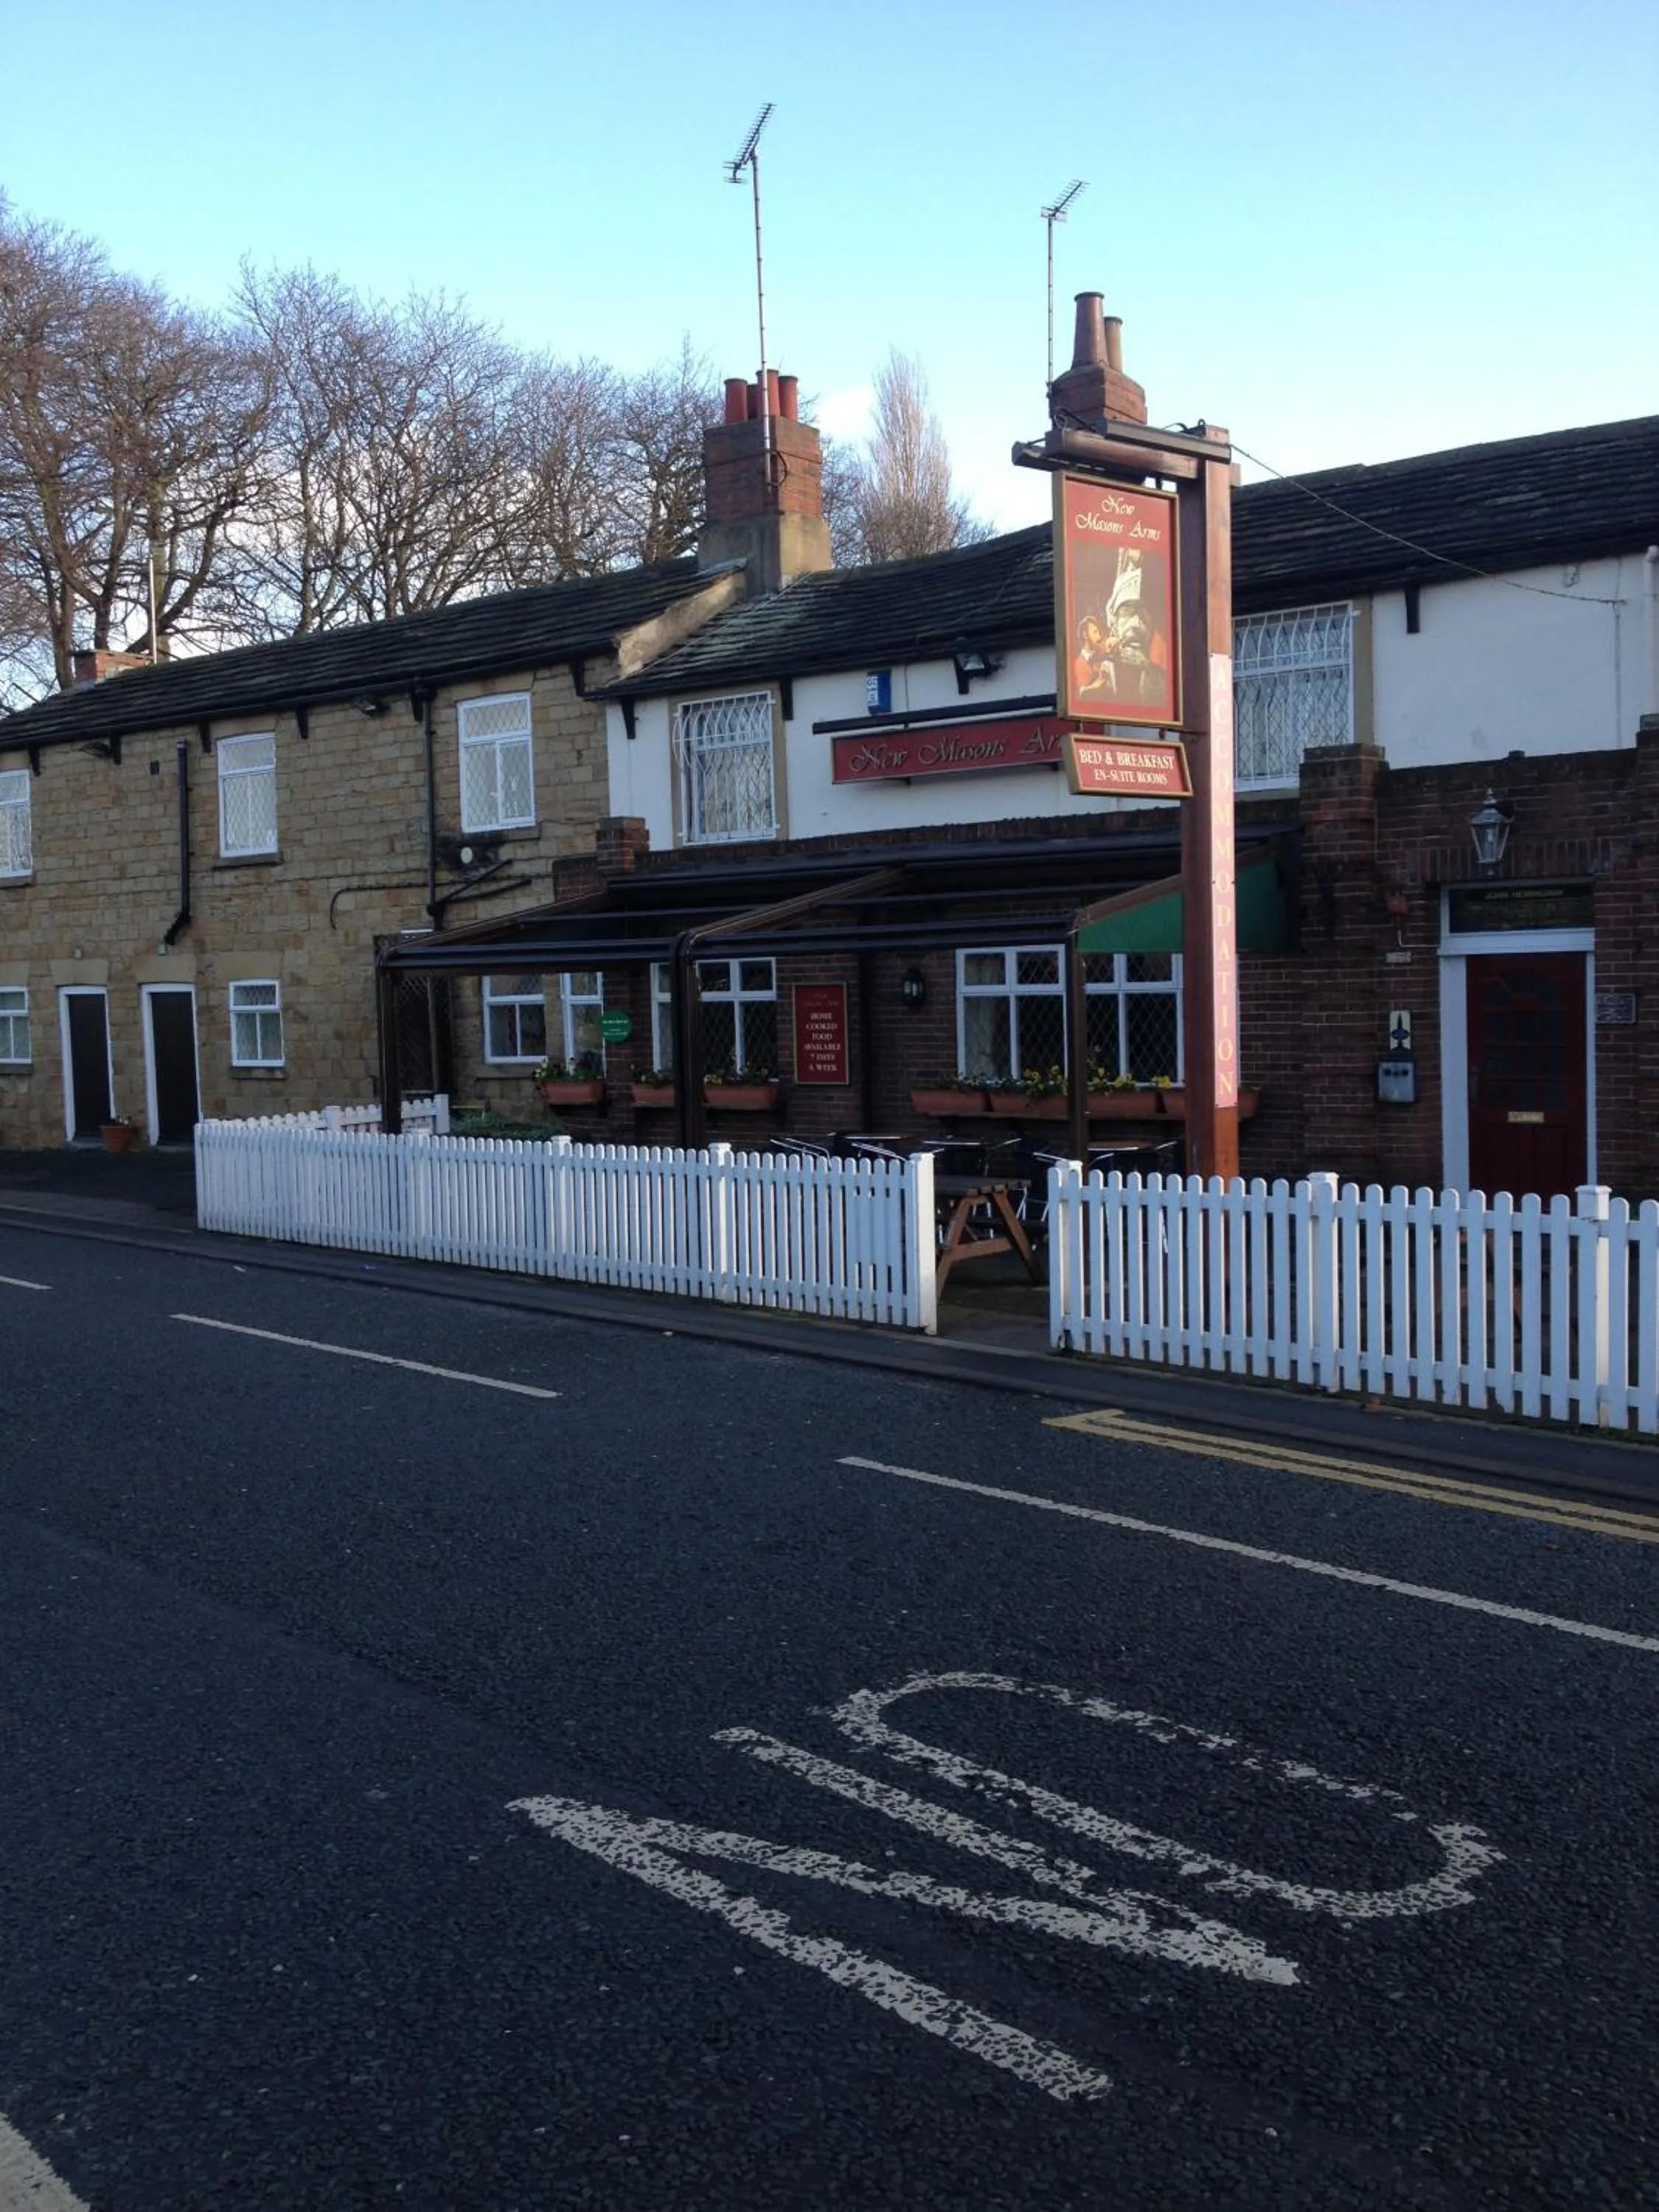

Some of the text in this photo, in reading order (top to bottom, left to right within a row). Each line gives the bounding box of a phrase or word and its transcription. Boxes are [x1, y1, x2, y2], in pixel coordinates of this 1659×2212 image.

[1101, 495, 1135, 515] New
[1075, 512, 1161, 541] Masons Arms
[849, 726, 1063, 773] New Masons Ar
[1079, 749, 1175, 770] BED & BREAKFAST
[1094, 768, 1168, 785] EN-SUITE ROOMS
[1214, 666, 1234, 1096] ACCOMMODATION
